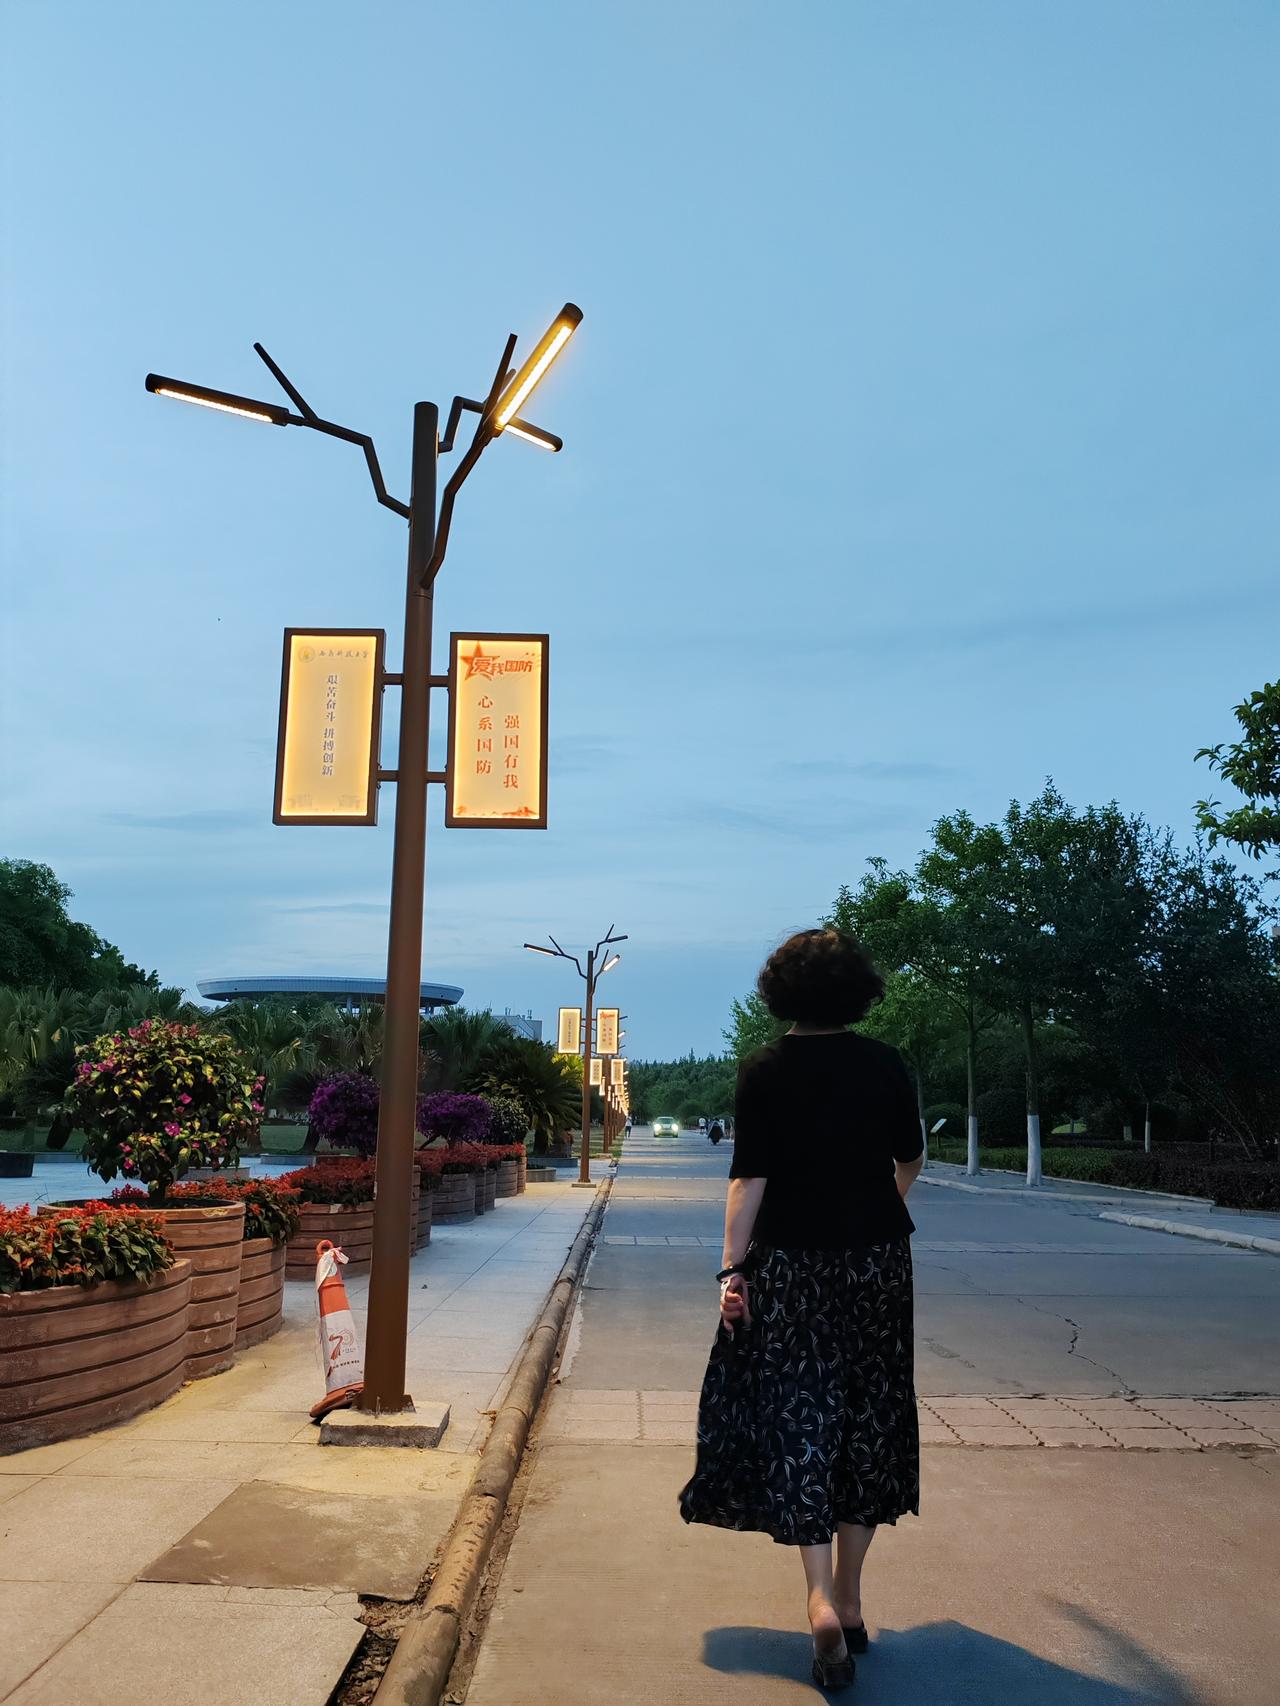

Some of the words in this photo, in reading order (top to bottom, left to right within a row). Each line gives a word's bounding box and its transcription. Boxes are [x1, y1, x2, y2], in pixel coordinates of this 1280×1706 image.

[472, 657, 534, 676] 爱我国防
[476, 695, 493, 775] 心系国防
[503, 714, 520, 789] 强国有我
